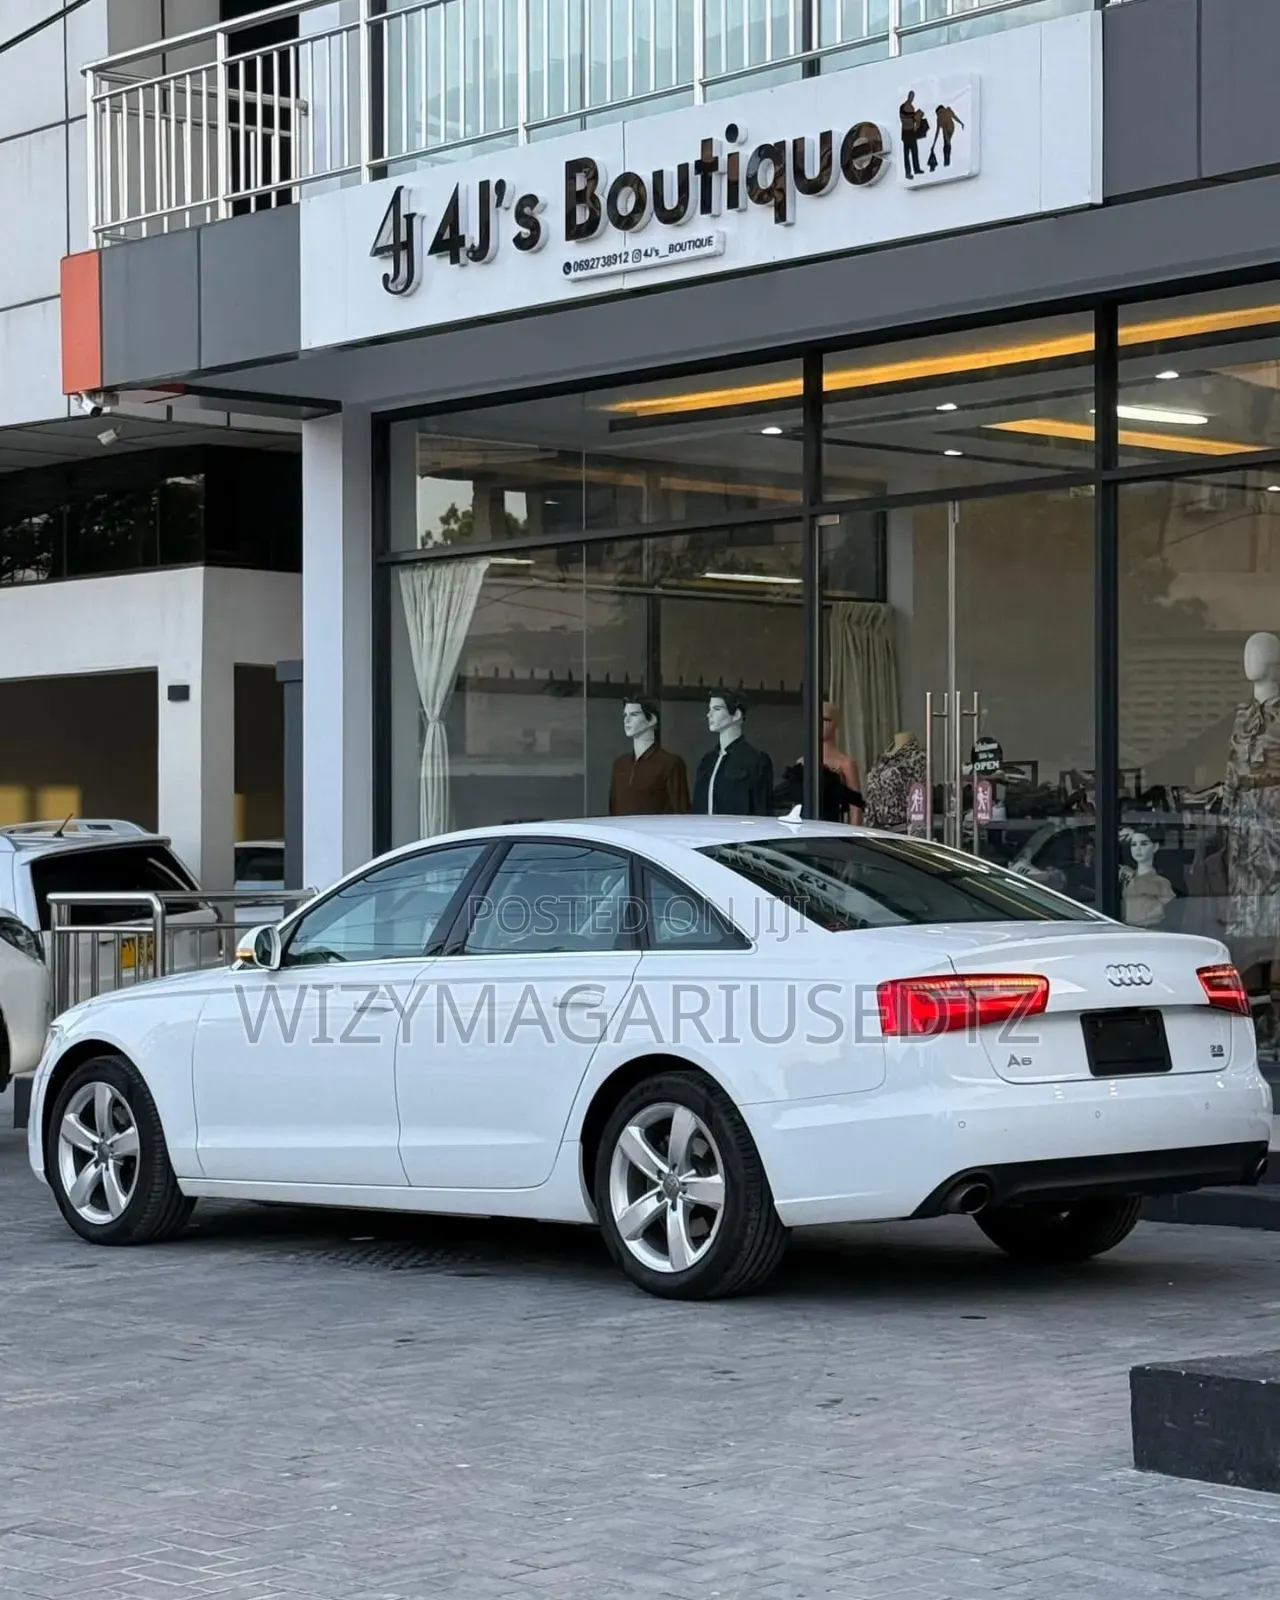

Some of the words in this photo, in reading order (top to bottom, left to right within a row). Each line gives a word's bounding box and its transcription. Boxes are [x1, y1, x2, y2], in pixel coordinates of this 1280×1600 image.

[427, 179, 543, 265] 4J's
[565, 122, 888, 242] Boutique
[573, 250, 629, 273] 0692738912
[973, 761, 1000, 771] OPEN
[1007, 1053, 1032, 1068] A6
